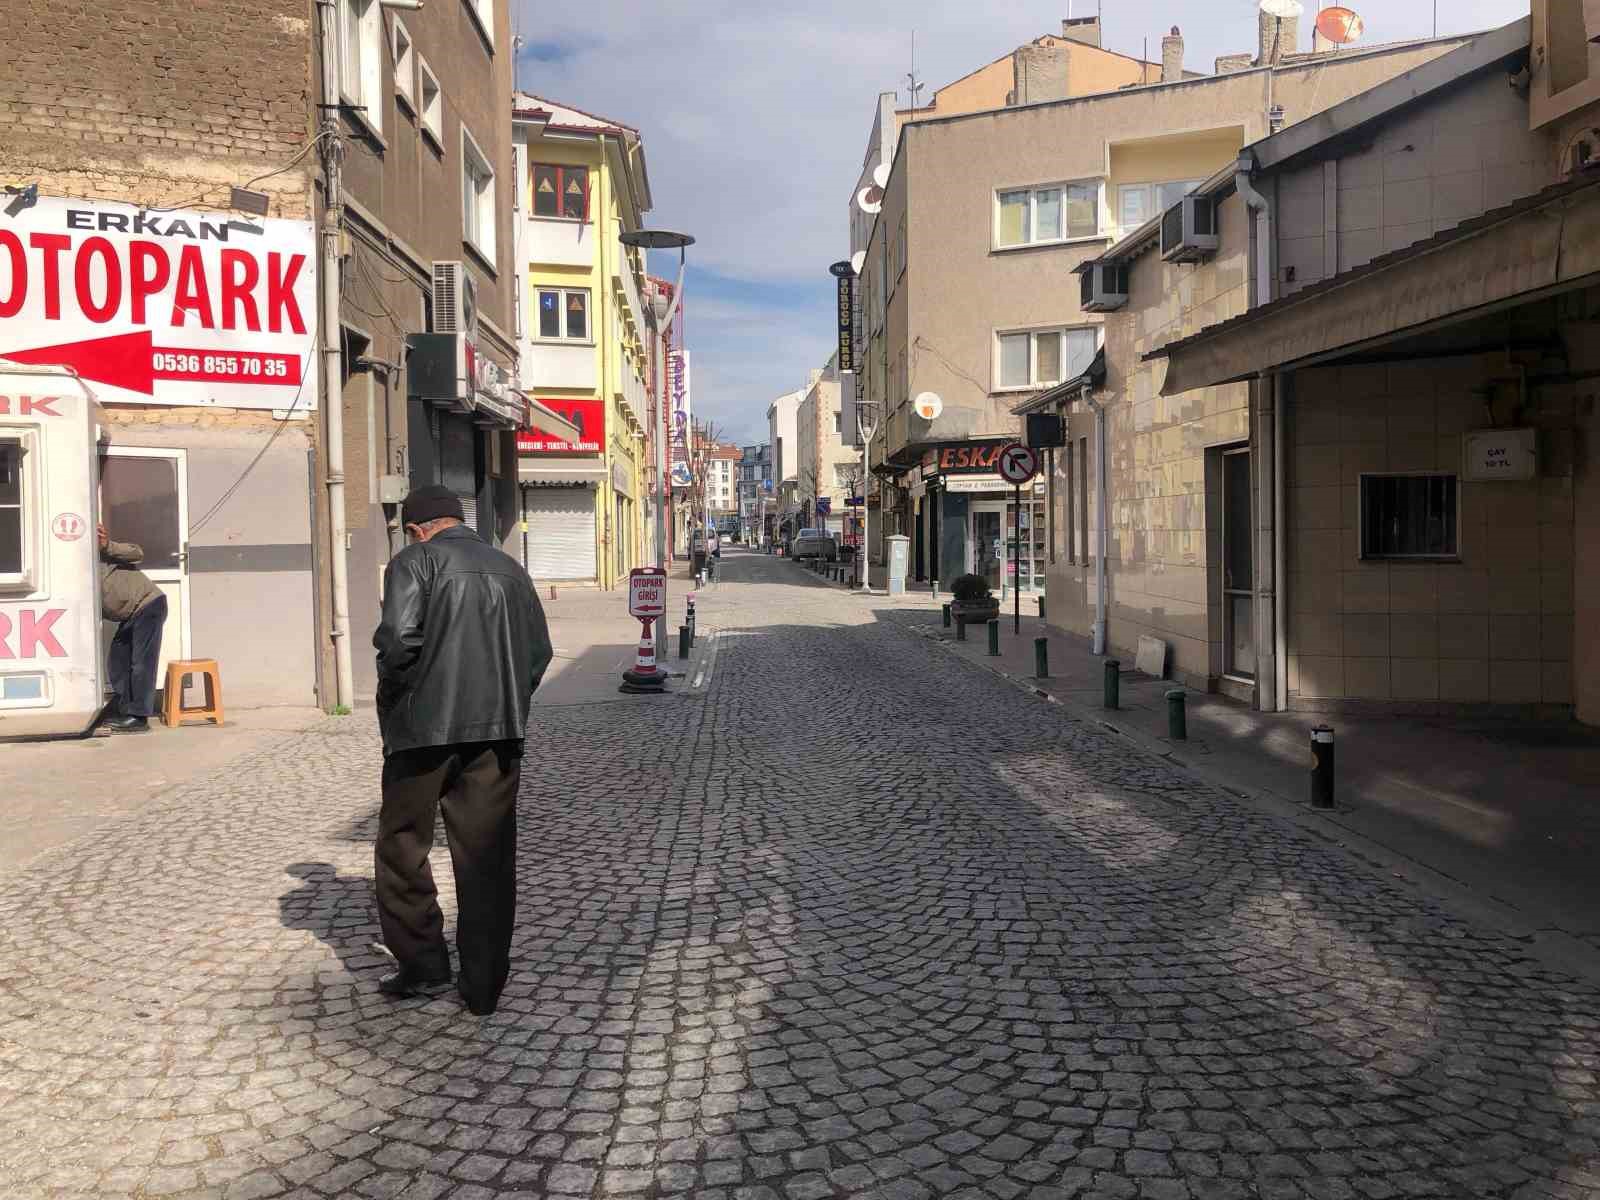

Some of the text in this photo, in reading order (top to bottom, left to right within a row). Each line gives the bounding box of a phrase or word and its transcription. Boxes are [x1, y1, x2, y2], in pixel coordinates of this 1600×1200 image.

[66, 209, 229, 242] ERKAN
[0, 229, 307, 335] OTOPARK
[153, 352, 287, 377] 0536 855 70 35
[634, 578, 663, 588] OTOPARK
